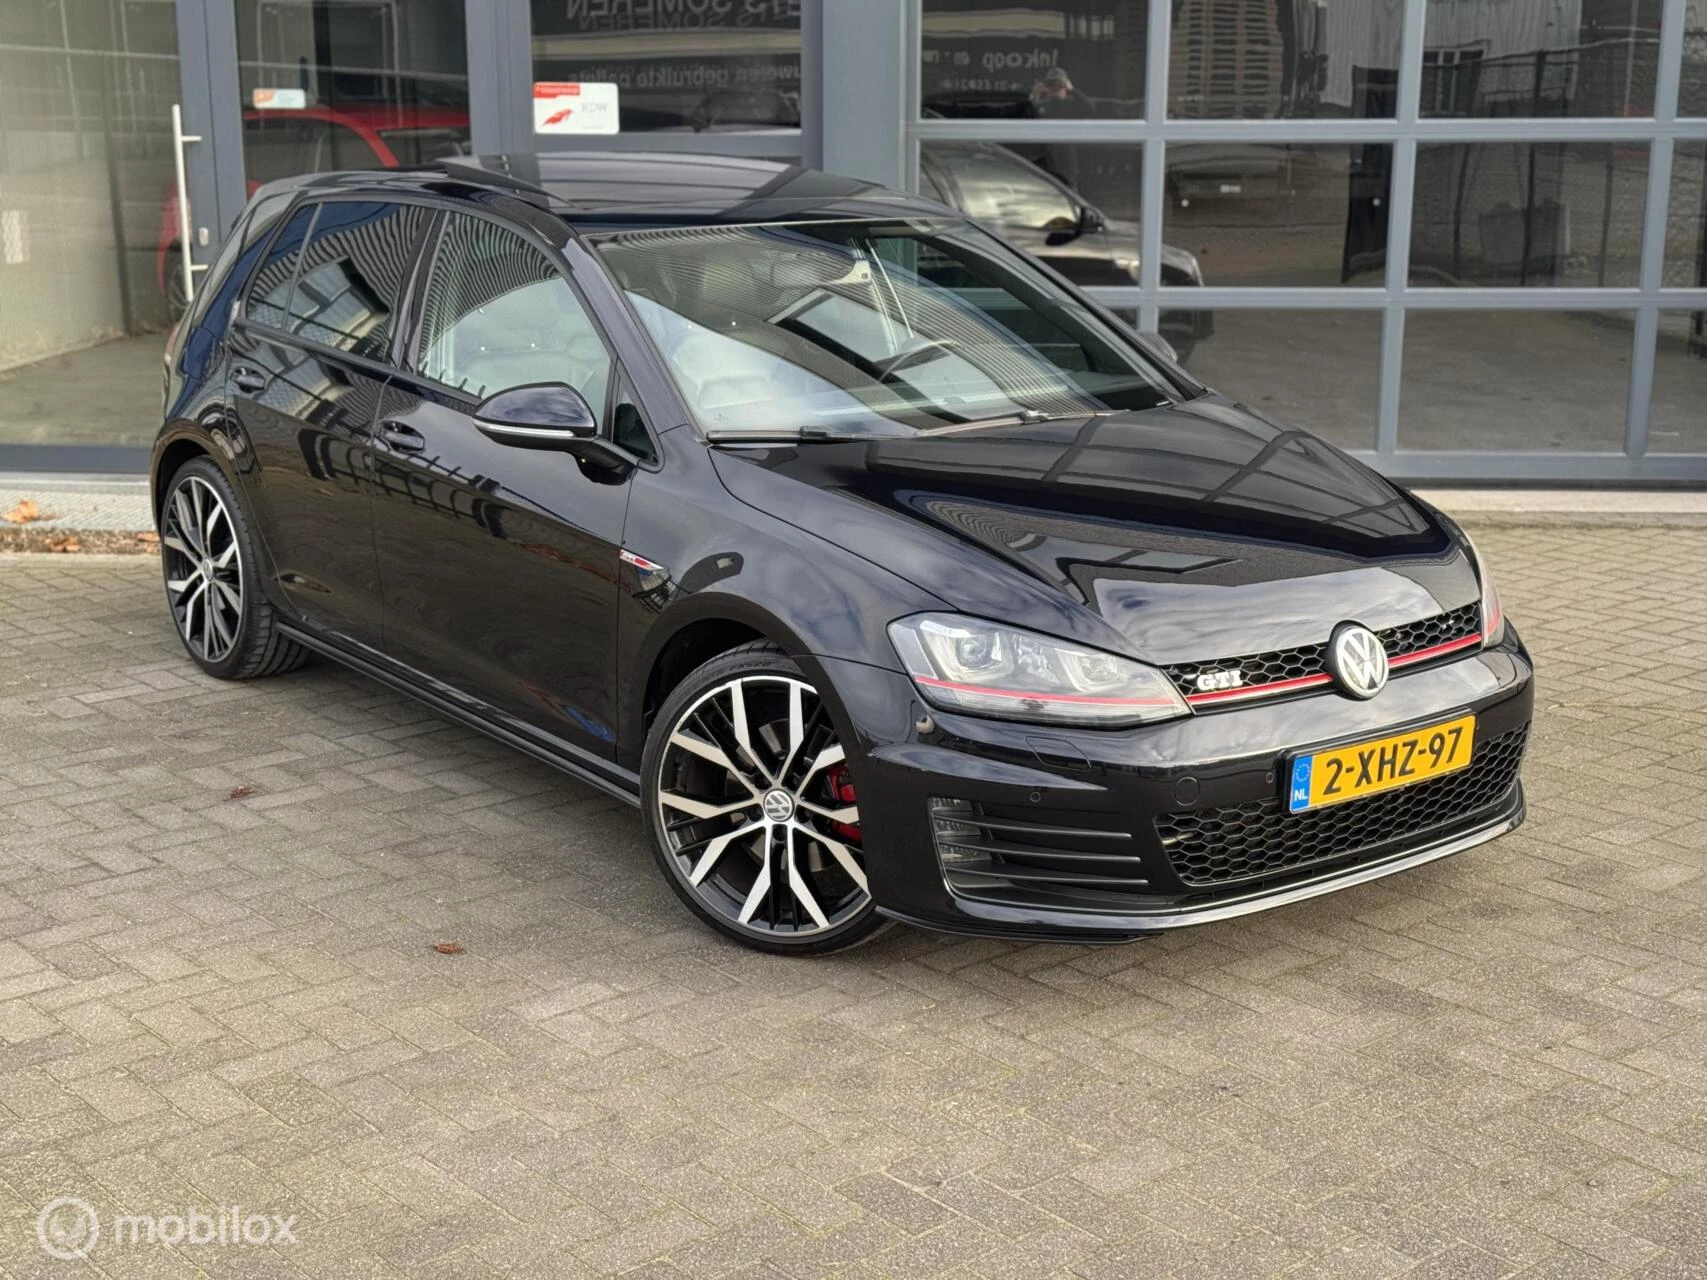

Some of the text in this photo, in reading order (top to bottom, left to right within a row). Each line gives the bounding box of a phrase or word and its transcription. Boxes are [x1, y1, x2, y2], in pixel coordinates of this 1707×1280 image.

[1196, 670, 1244, 691] GTI
[1322, 725, 1465, 796] 2-XHZ-97
[1293, 788, 1308, 802] NL
